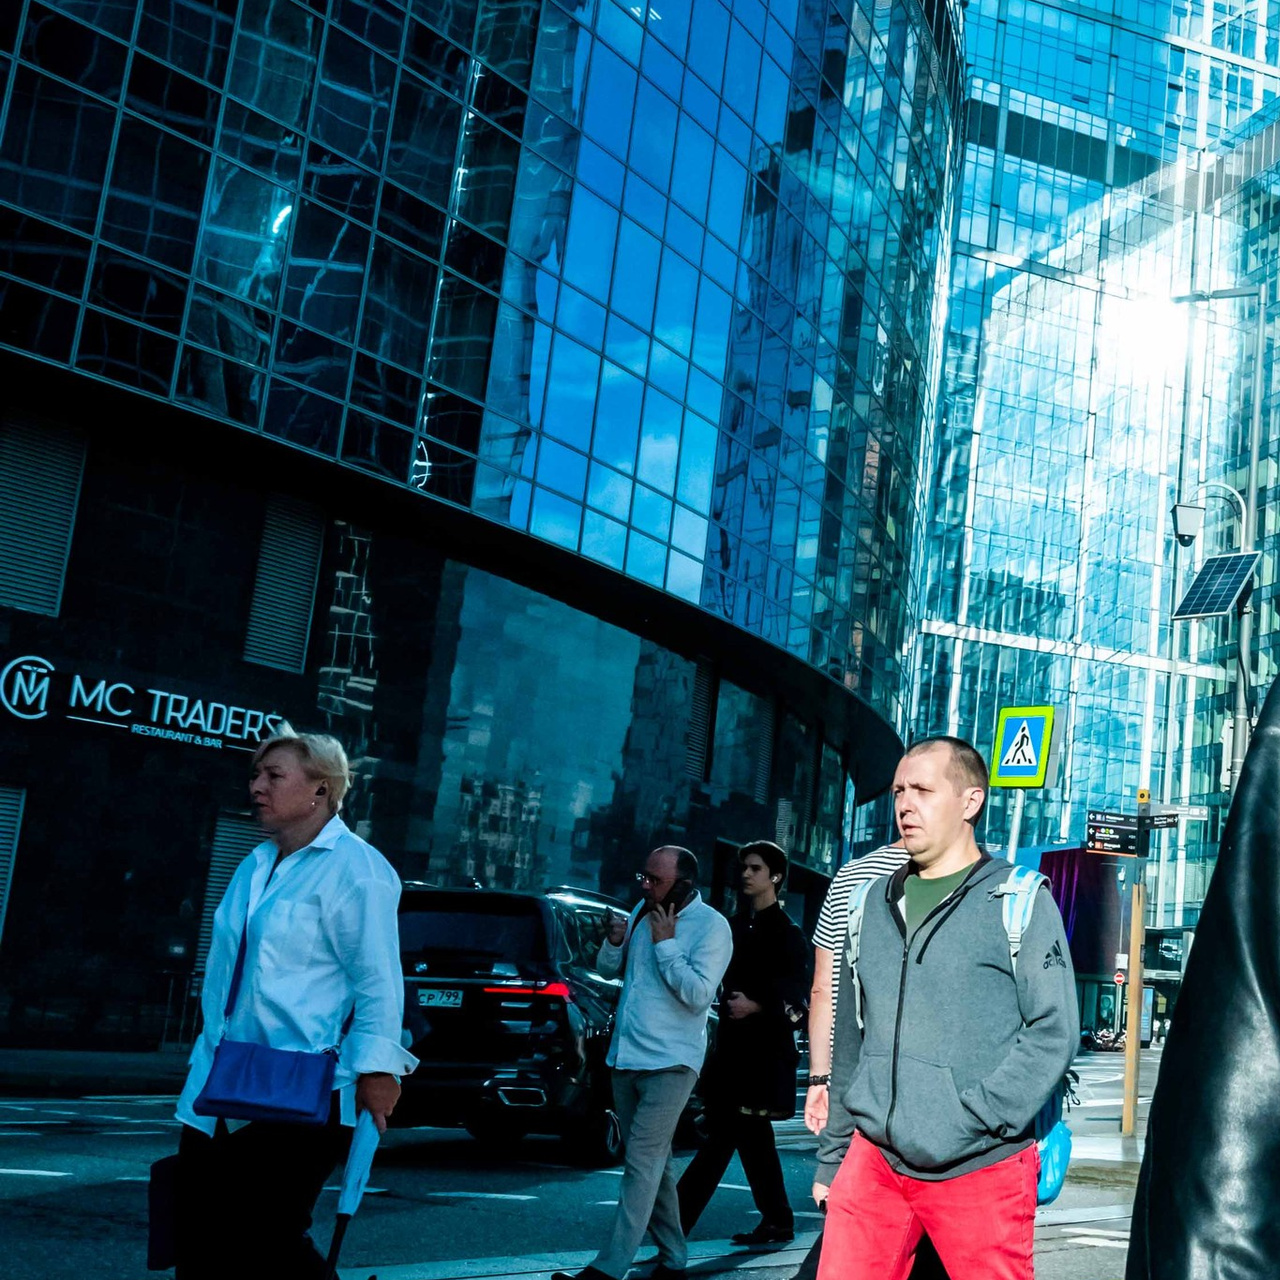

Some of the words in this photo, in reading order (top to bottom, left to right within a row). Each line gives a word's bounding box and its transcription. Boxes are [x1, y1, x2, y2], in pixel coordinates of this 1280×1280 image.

[69, 674, 135, 717] MC
[131, 723, 194, 744] RESTAURANT
[203, 737, 223, 749] BAR
